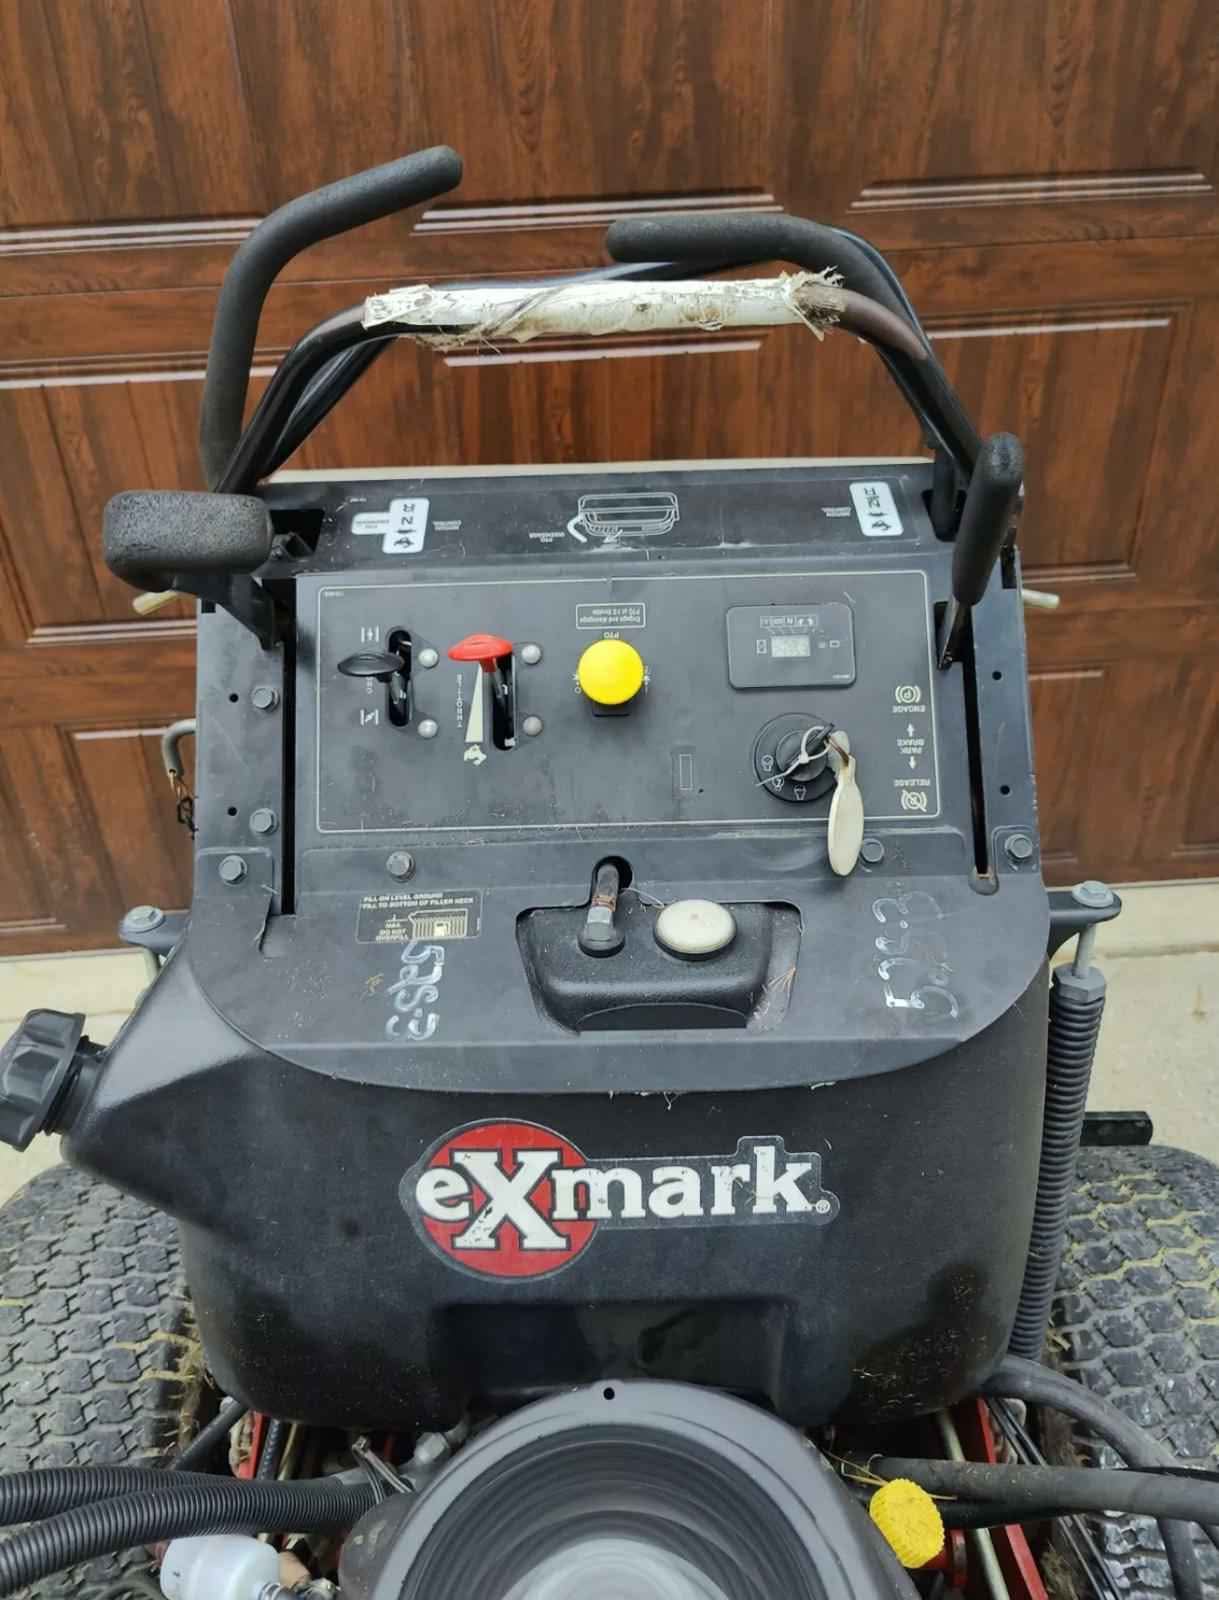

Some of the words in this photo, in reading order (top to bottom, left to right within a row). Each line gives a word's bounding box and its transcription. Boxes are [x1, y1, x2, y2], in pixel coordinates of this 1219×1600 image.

[603, 631, 620, 639] PTO
[892, 704, 926, 713] ENGAGE
[897, 738, 925, 747] BRAKE
[900, 746, 922, 754] PARK
[893, 778, 931, 787] RELEASE
